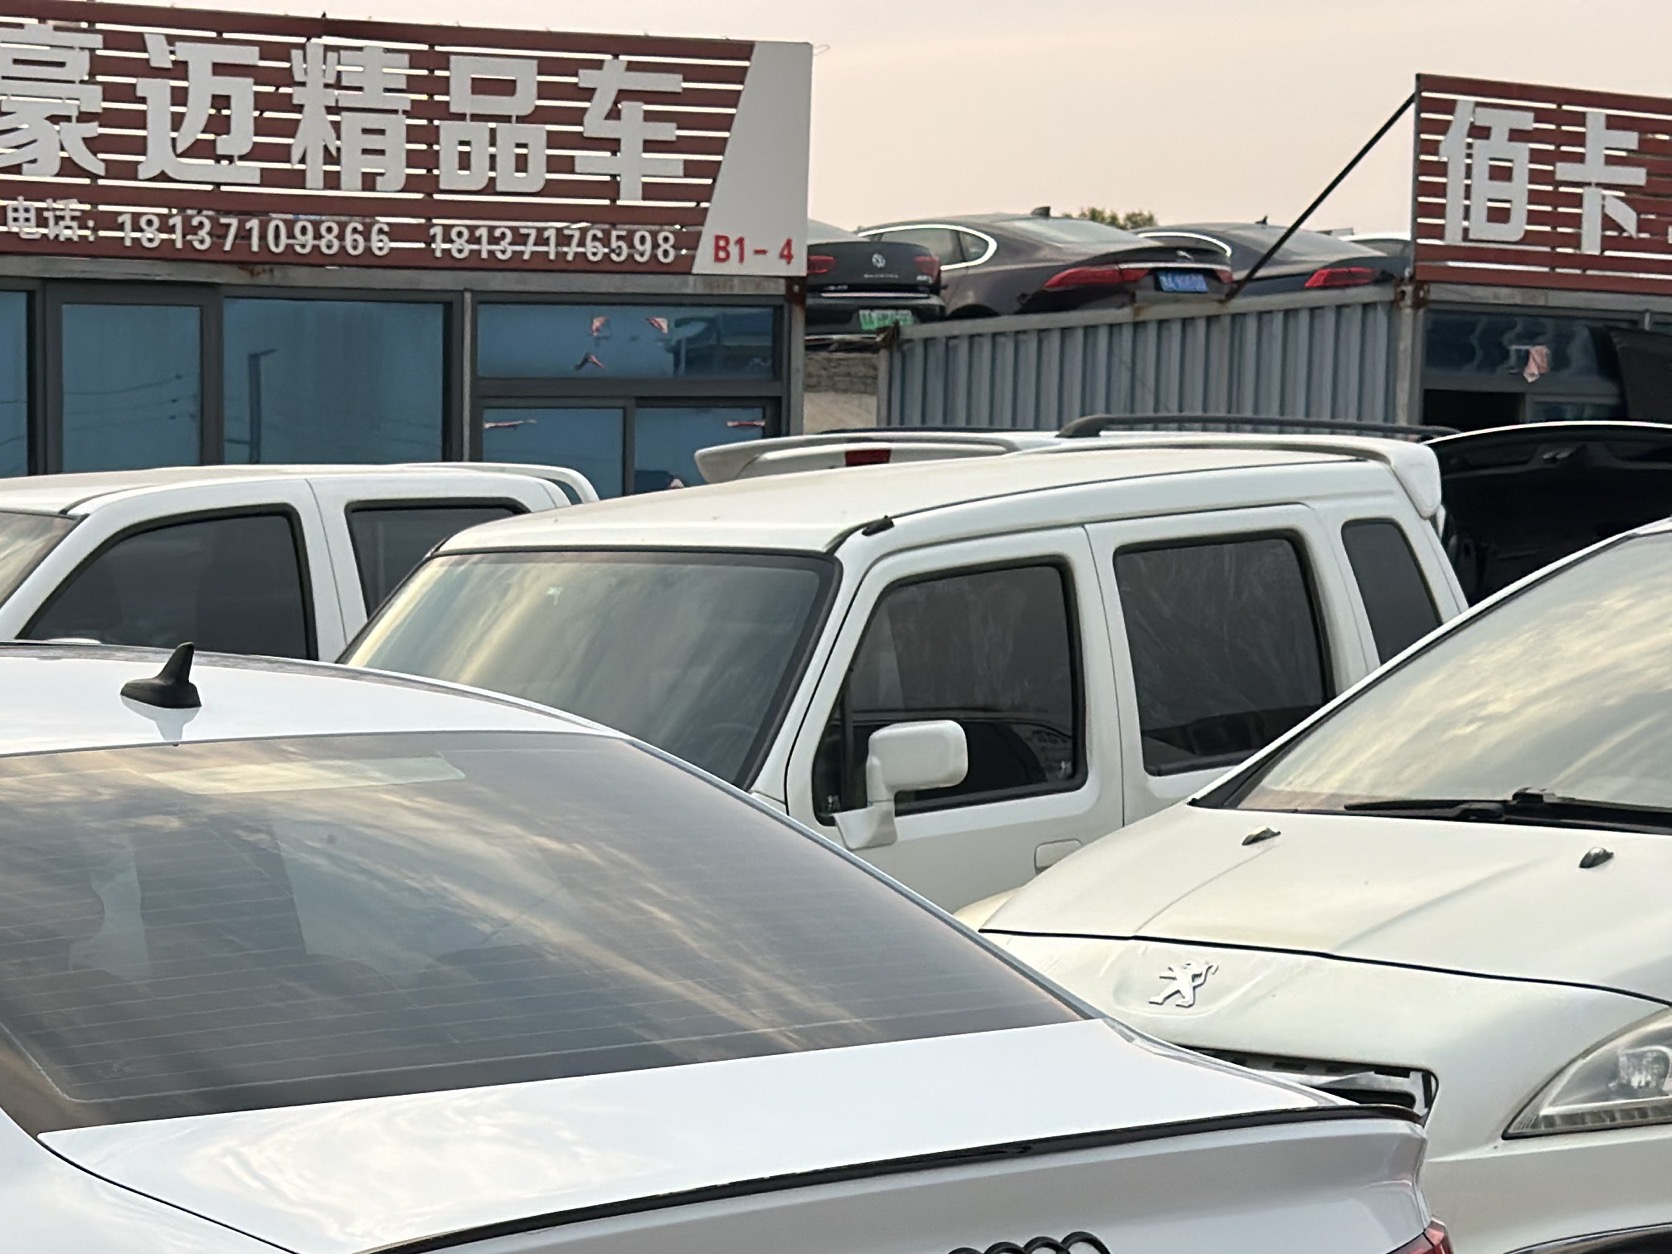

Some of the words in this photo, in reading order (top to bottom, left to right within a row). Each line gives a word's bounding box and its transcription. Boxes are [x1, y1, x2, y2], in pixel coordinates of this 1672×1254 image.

[1439, 99, 1672, 255] 佰卡
[117, 212, 391, 257] 18137109866
[429, 225, 676, 264] 18137176598
